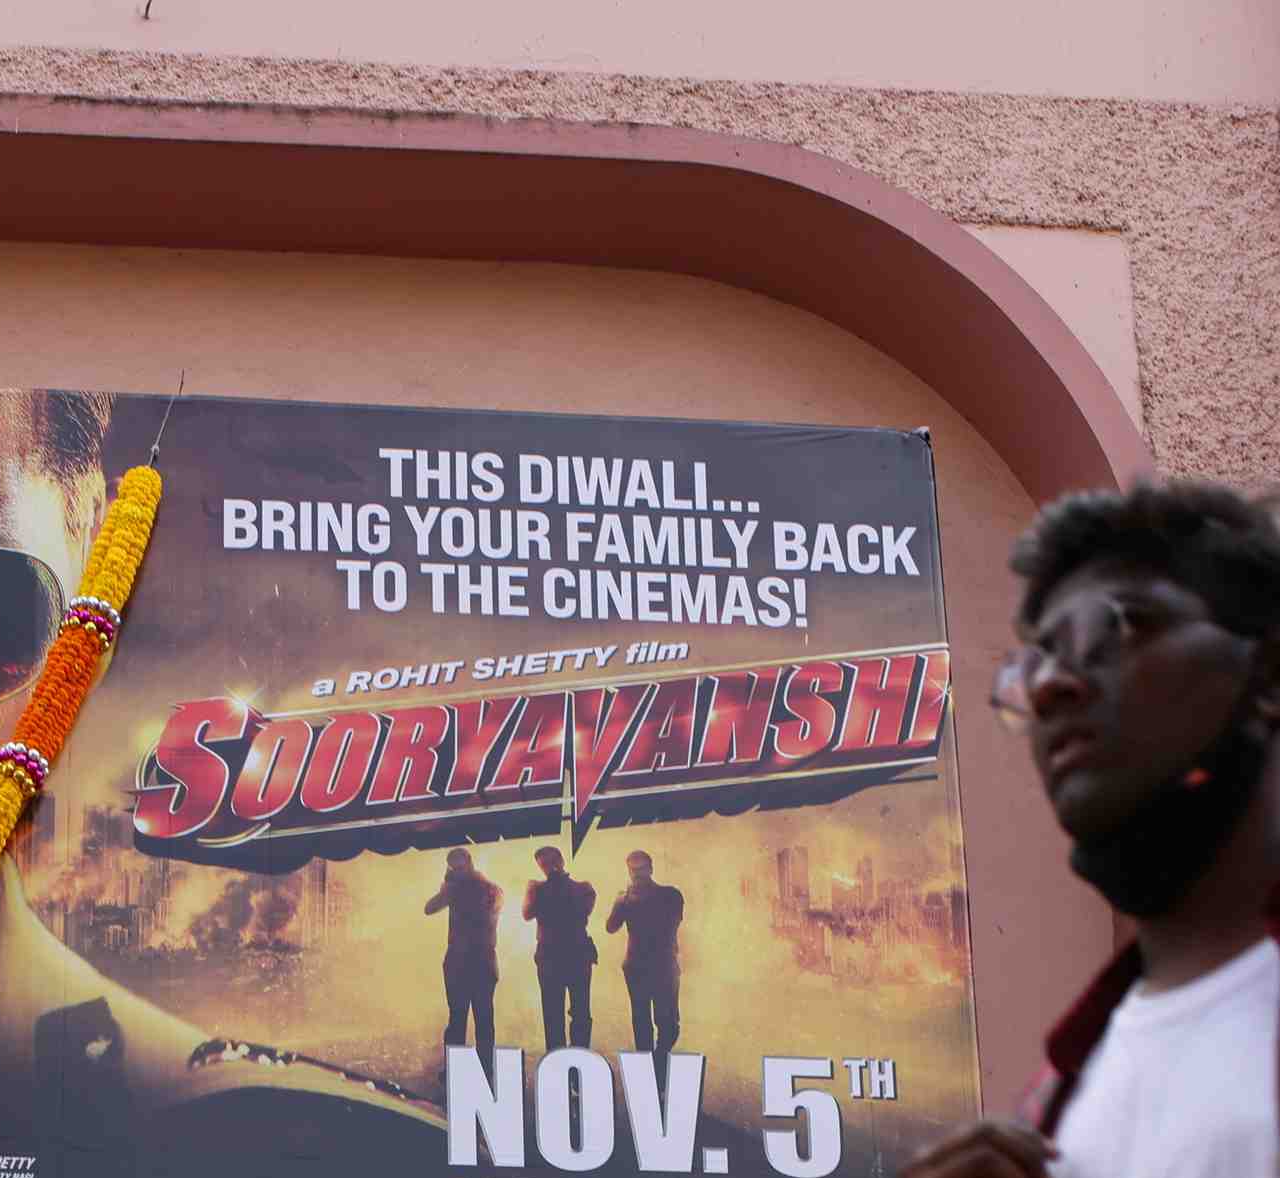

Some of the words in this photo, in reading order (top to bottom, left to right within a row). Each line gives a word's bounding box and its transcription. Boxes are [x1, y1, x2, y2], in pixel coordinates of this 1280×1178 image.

[379, 448, 506, 502] THIS
[519, 455, 761, 513] DIWALI...
[223, 498, 391, 555] BRING
[414, 507, 552, 562] YOUR
[567, 512, 759, 570] FAMILY
[772, 522, 920, 577] BACK
[336, 559, 408, 613] TO
[421, 564, 531, 618] THE
[543, 567, 809, 629] CINEMAS!
[311, 676, 336, 698] a
[346, 659, 465, 694] ROHIT
[472, 646, 618, 680] SHETTY
[624, 639, 689, 665] film
[132, 649, 952, 840] SOORYAVANSHI
[445, 1044, 729, 1174] NOV.
